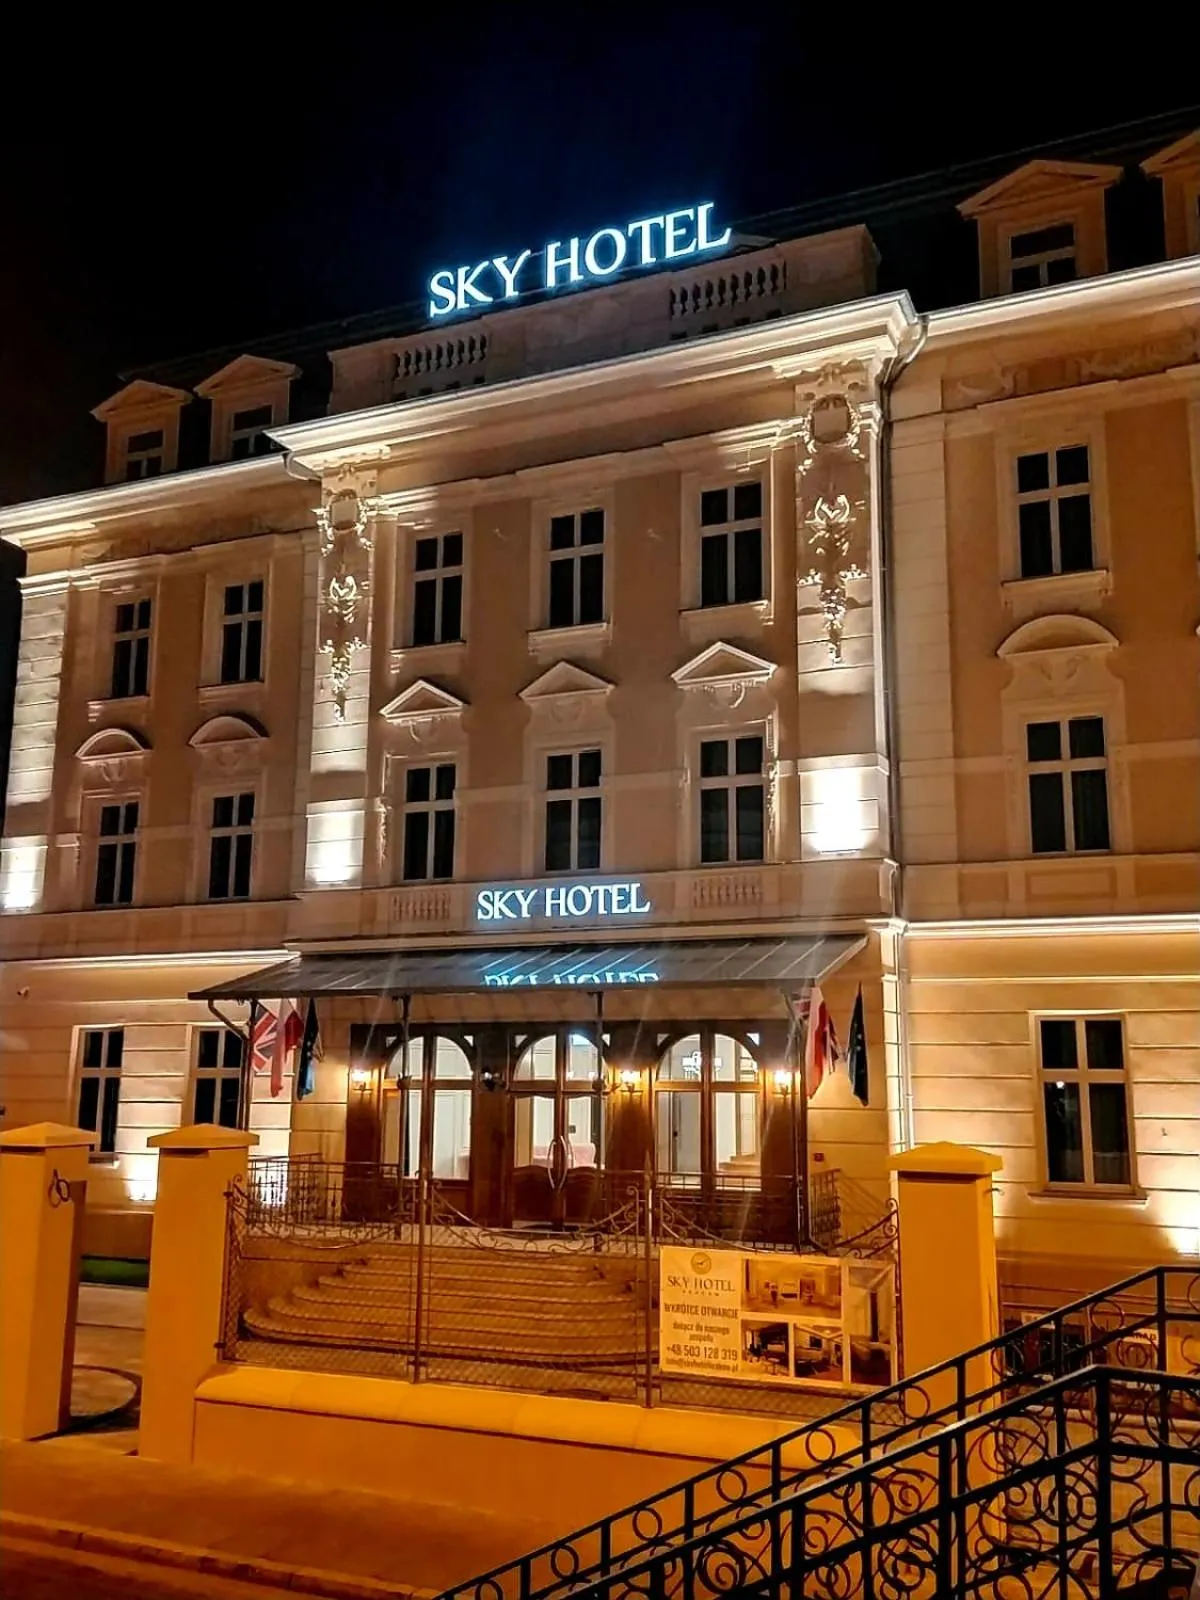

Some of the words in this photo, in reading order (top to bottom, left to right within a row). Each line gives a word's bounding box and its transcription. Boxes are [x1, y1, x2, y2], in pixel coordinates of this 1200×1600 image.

[429, 250, 531, 318] SKY
[546, 202, 732, 288] HOTEL
[477, 889, 538, 920] SKY
[545, 882, 650, 917] HOTEL
[667, 1275, 689, 1288] SKY
[694, 1276, 736, 1292] HOTEL
[684, 1344, 701, 1358] 503
